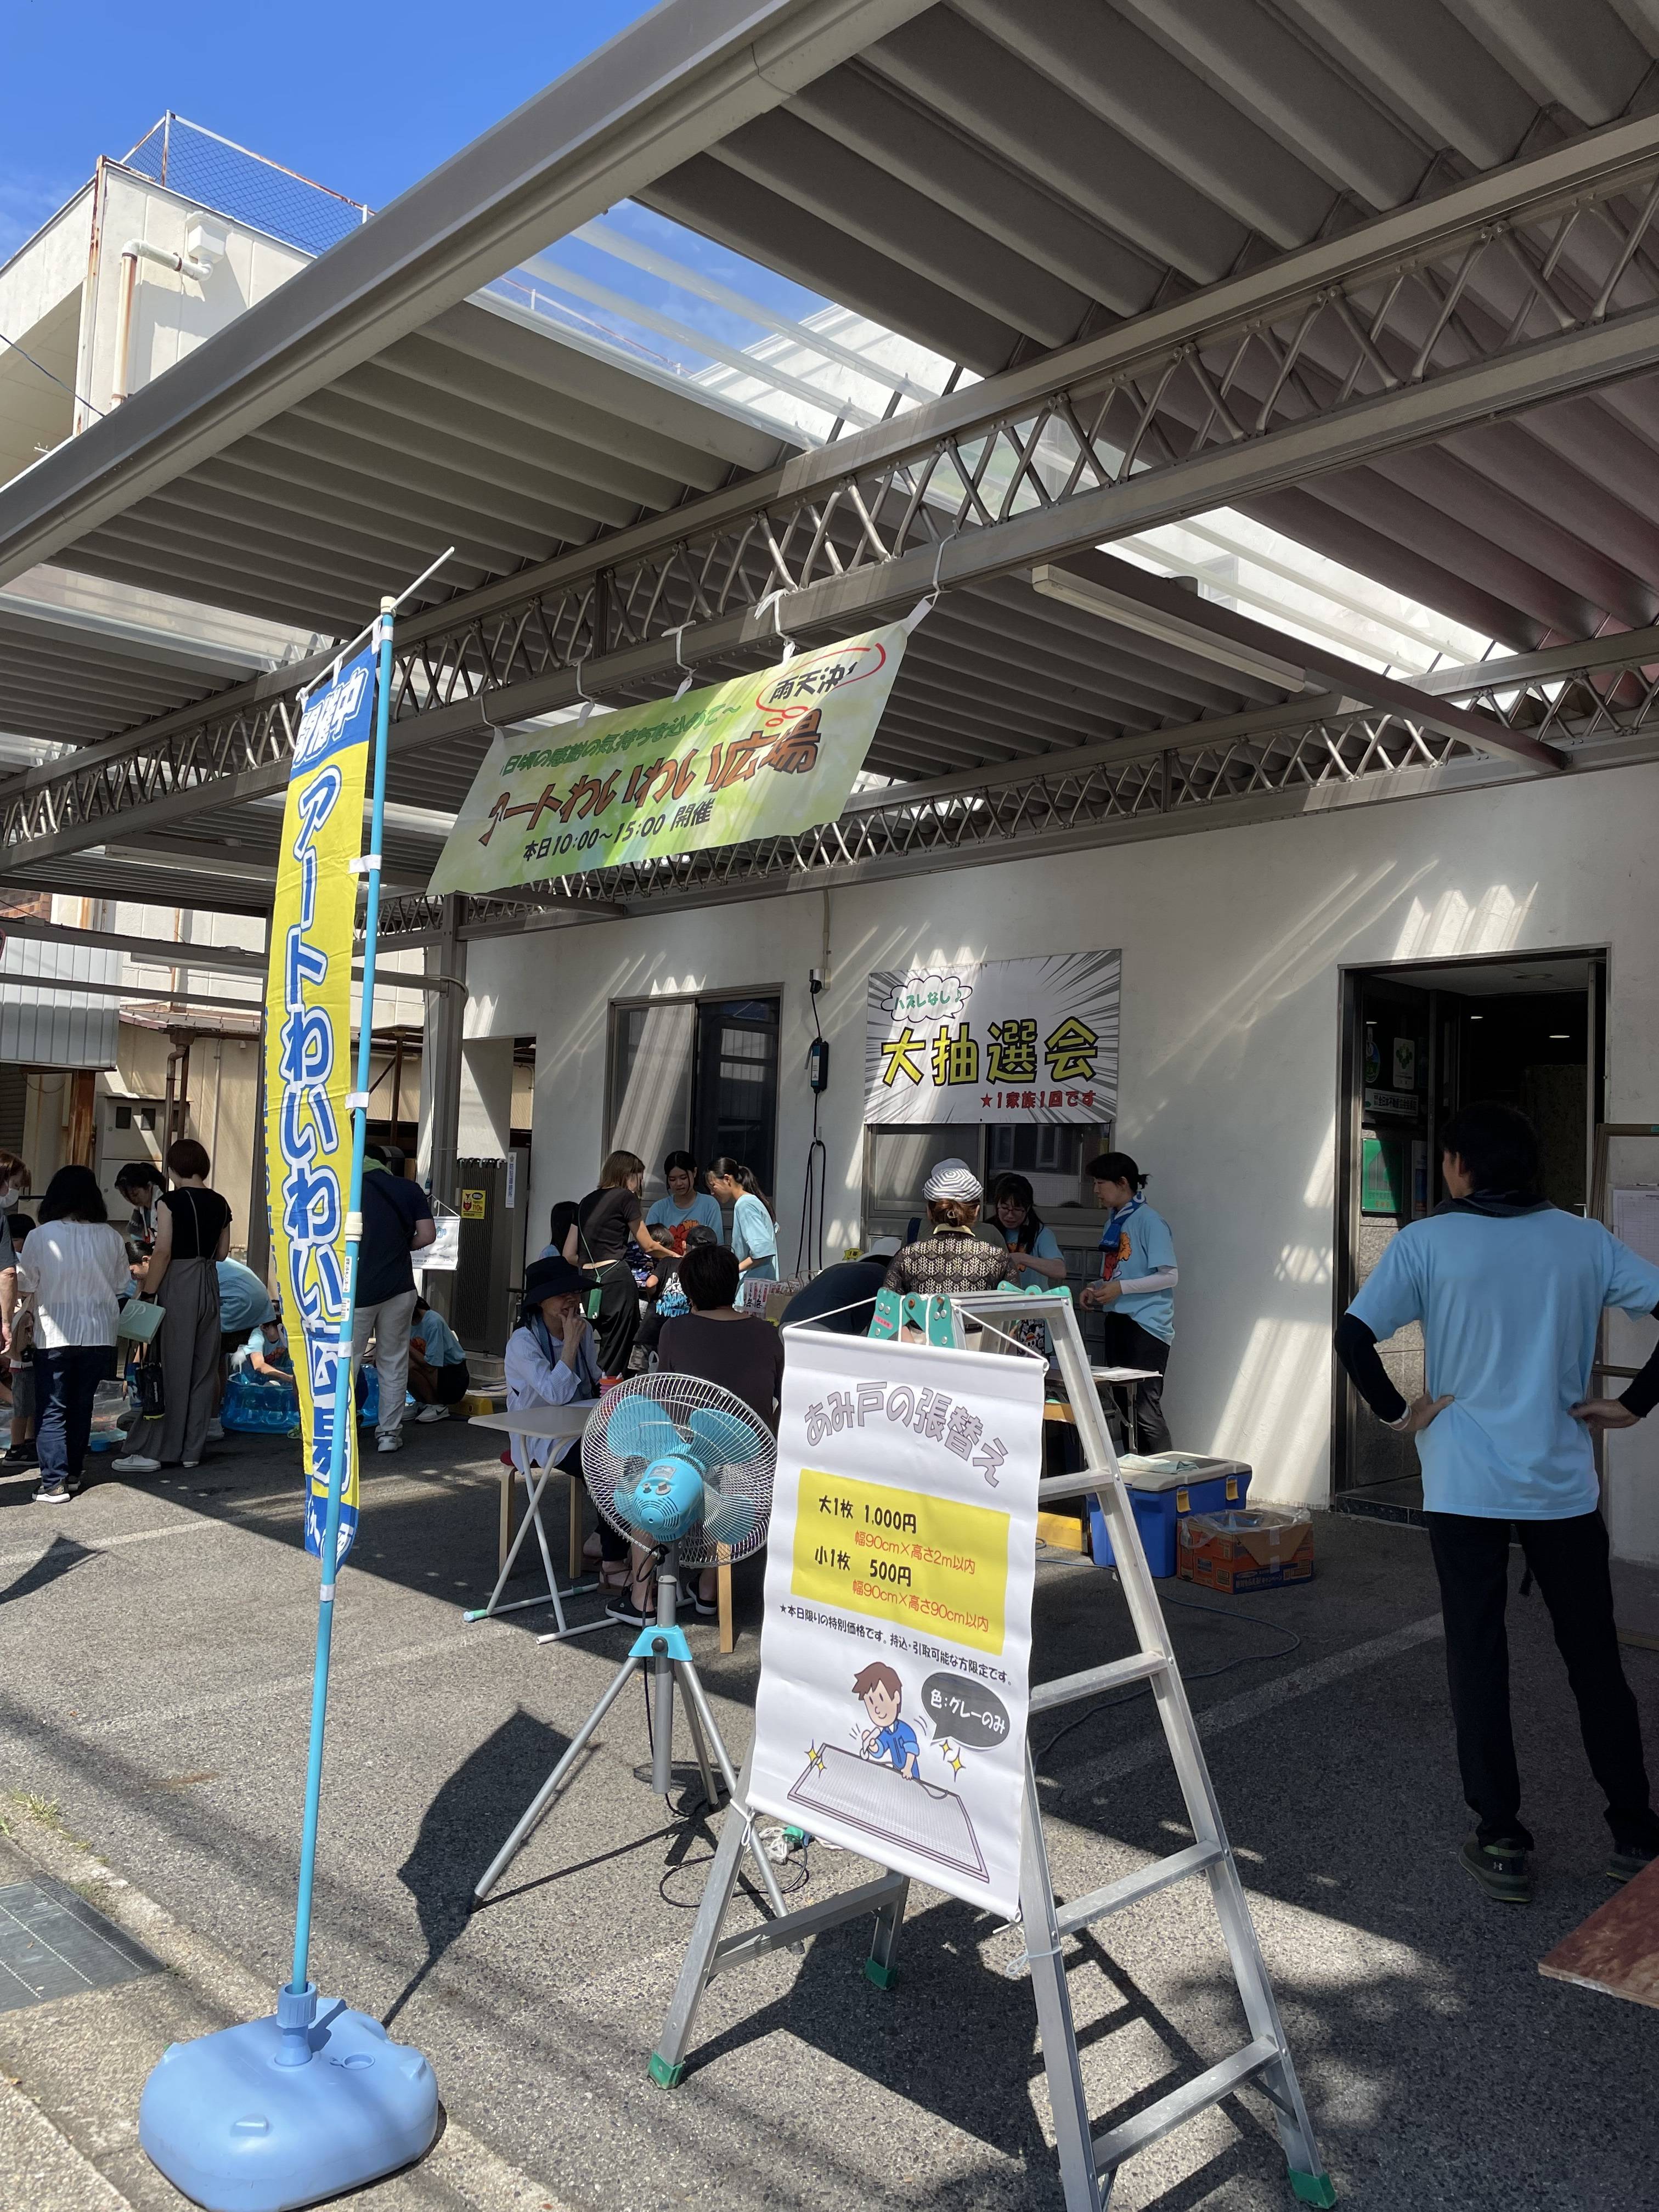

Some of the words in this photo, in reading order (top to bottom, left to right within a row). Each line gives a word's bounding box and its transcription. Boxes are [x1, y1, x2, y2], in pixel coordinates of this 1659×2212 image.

[769, 661, 858, 704] 雨天決
[669, 797, 716, 832] 開催
[881, 1016, 1099, 1087] 大抽選会
[804, 1381, 1008, 1488] あみ戸の張替え
[819, 1494, 854, 1520] 大1枚
[865, 1504, 917, 1534] 1,000円
[814, 1545, 851, 1572] 小1枚
[870, 1559, 912, 1587] 500円
